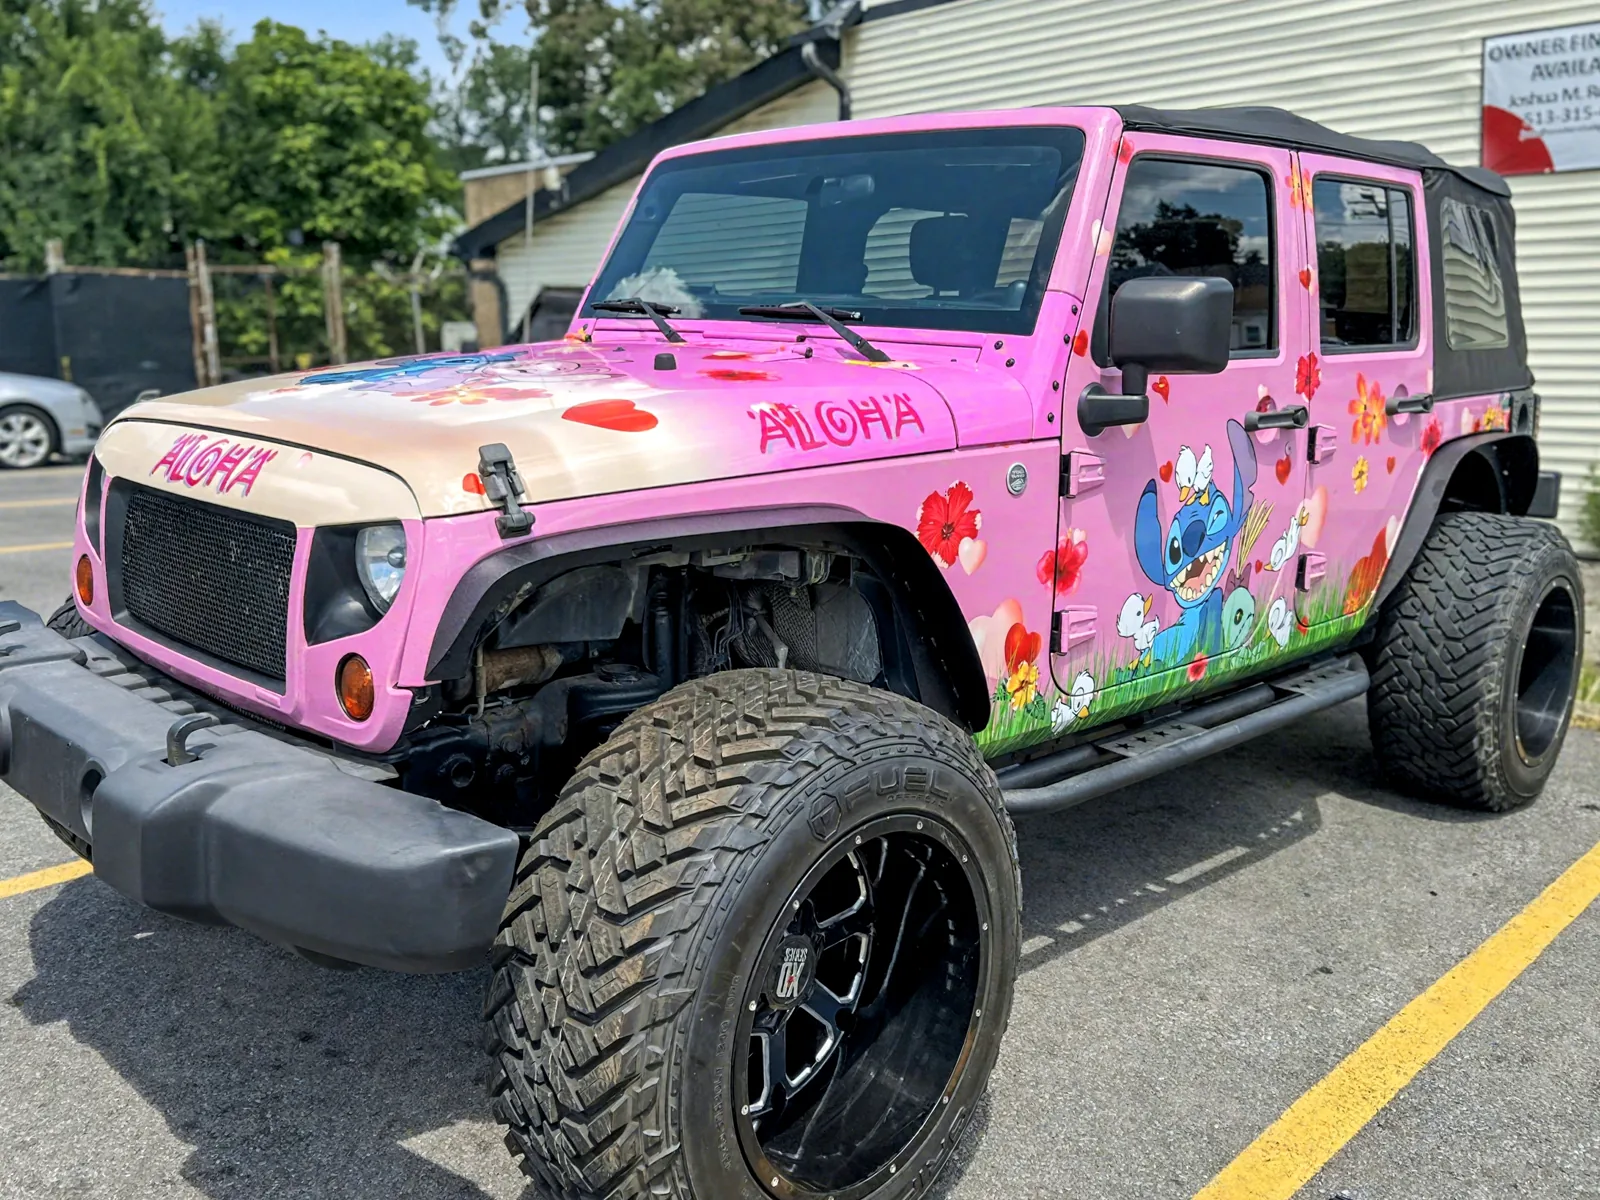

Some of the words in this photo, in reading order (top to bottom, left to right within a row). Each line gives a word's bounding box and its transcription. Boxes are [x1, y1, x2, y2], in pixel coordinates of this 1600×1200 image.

[1488, 36, 1565, 62] OWNER
[1525, 105, 1600, 125] 513-315-
[746, 393, 925, 454] ALOHA
[149, 433, 279, 497] ALOHA
[844, 766, 953, 812] FUEL
